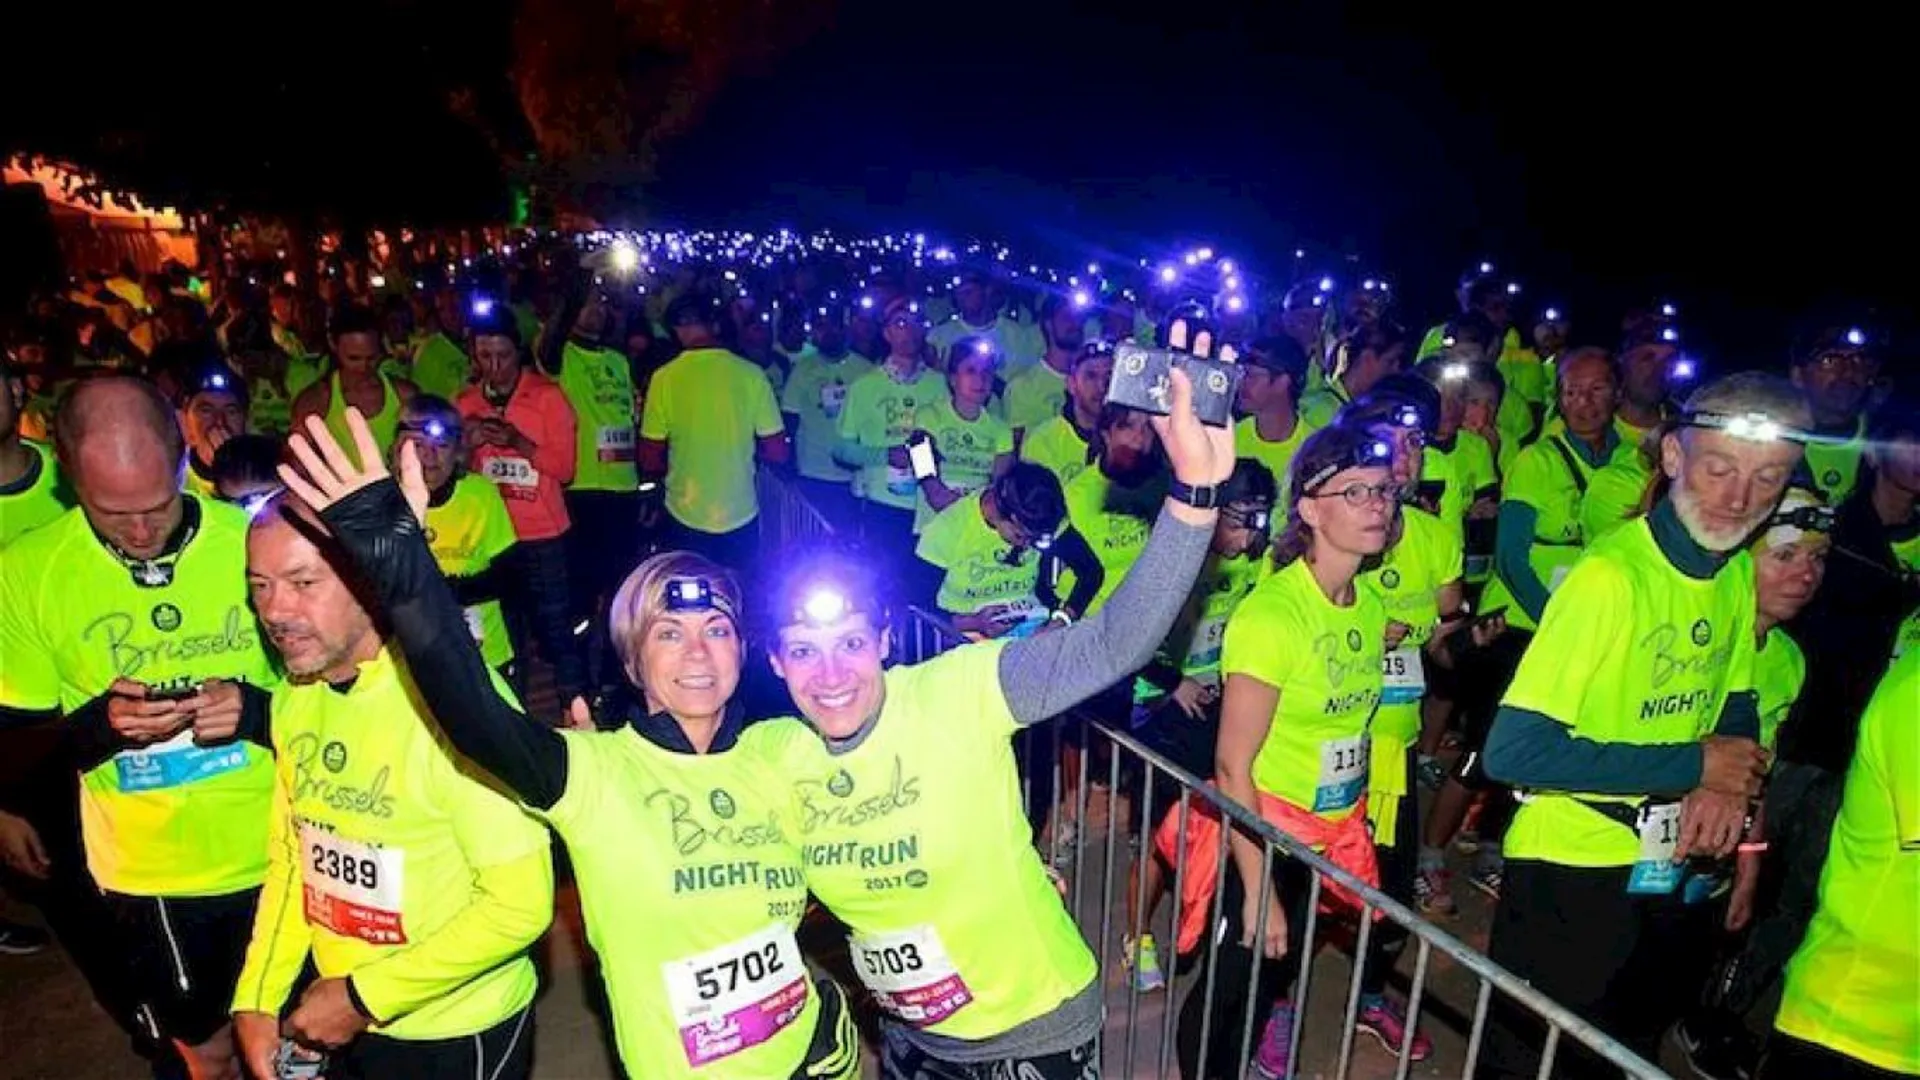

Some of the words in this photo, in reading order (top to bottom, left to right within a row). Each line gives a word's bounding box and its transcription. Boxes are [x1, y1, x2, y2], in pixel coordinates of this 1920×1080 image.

[84, 605, 254, 677] Brussels
[288, 732, 396, 818] Brussels
[312, 844, 378, 889] 2389
[861, 835, 919, 869] RUN
[674, 861, 760, 894] NIGHT
[864, 876, 901, 891] 2017
[695, 941, 785, 1000] 5702
[863, 943, 924, 975] 5703
